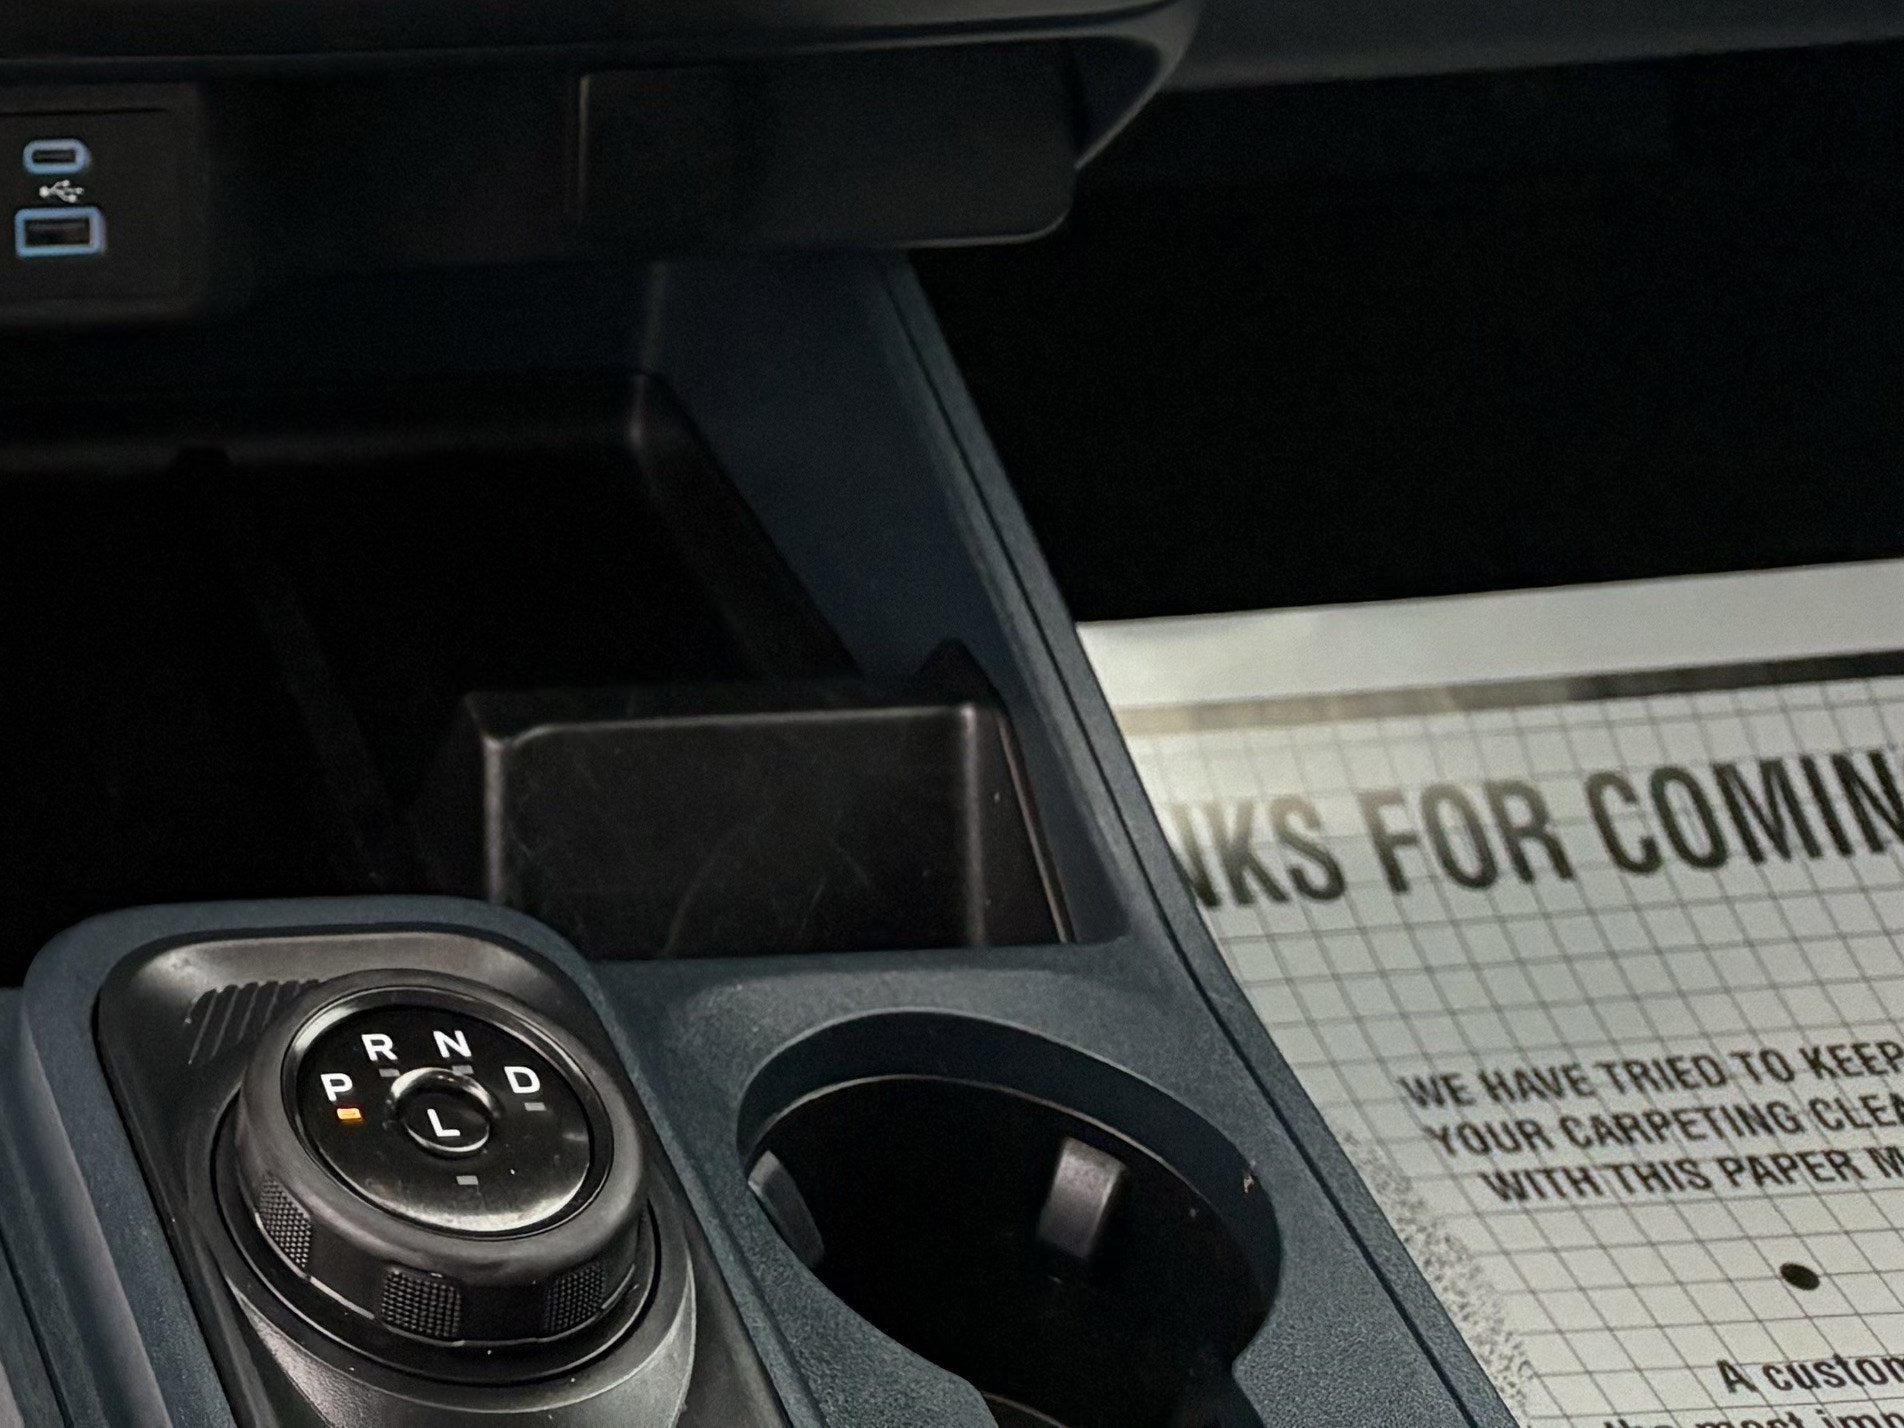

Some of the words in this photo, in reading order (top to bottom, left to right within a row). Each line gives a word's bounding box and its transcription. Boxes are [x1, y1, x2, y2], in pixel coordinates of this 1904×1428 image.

[1356, 776, 1575, 893] FOR
[360, 1032, 398, 1061] R
[432, 1029, 472, 1058] N
[320, 1072, 354, 1102] P
[503, 1065, 542, 1093] D
[1396, 1072, 1477, 1109] WE
[1478, 1062, 1596, 1103] HAVE
[1593, 1054, 1728, 1094] TRIED
[1728, 1047, 1796, 1084] TO
[1797, 1040, 1904, 1081] KEEP
[426, 1108, 461, 1137] L
[1422, 1118, 1557, 1157] YOUR
[1558, 1099, 1806, 1150] CARPETING
[1477, 1164, 1605, 1202] WITH
[1594, 1158, 1713, 1194] THIS
[1714, 1148, 1867, 1189] PAPER
[1716, 1357, 1760, 1394] A
